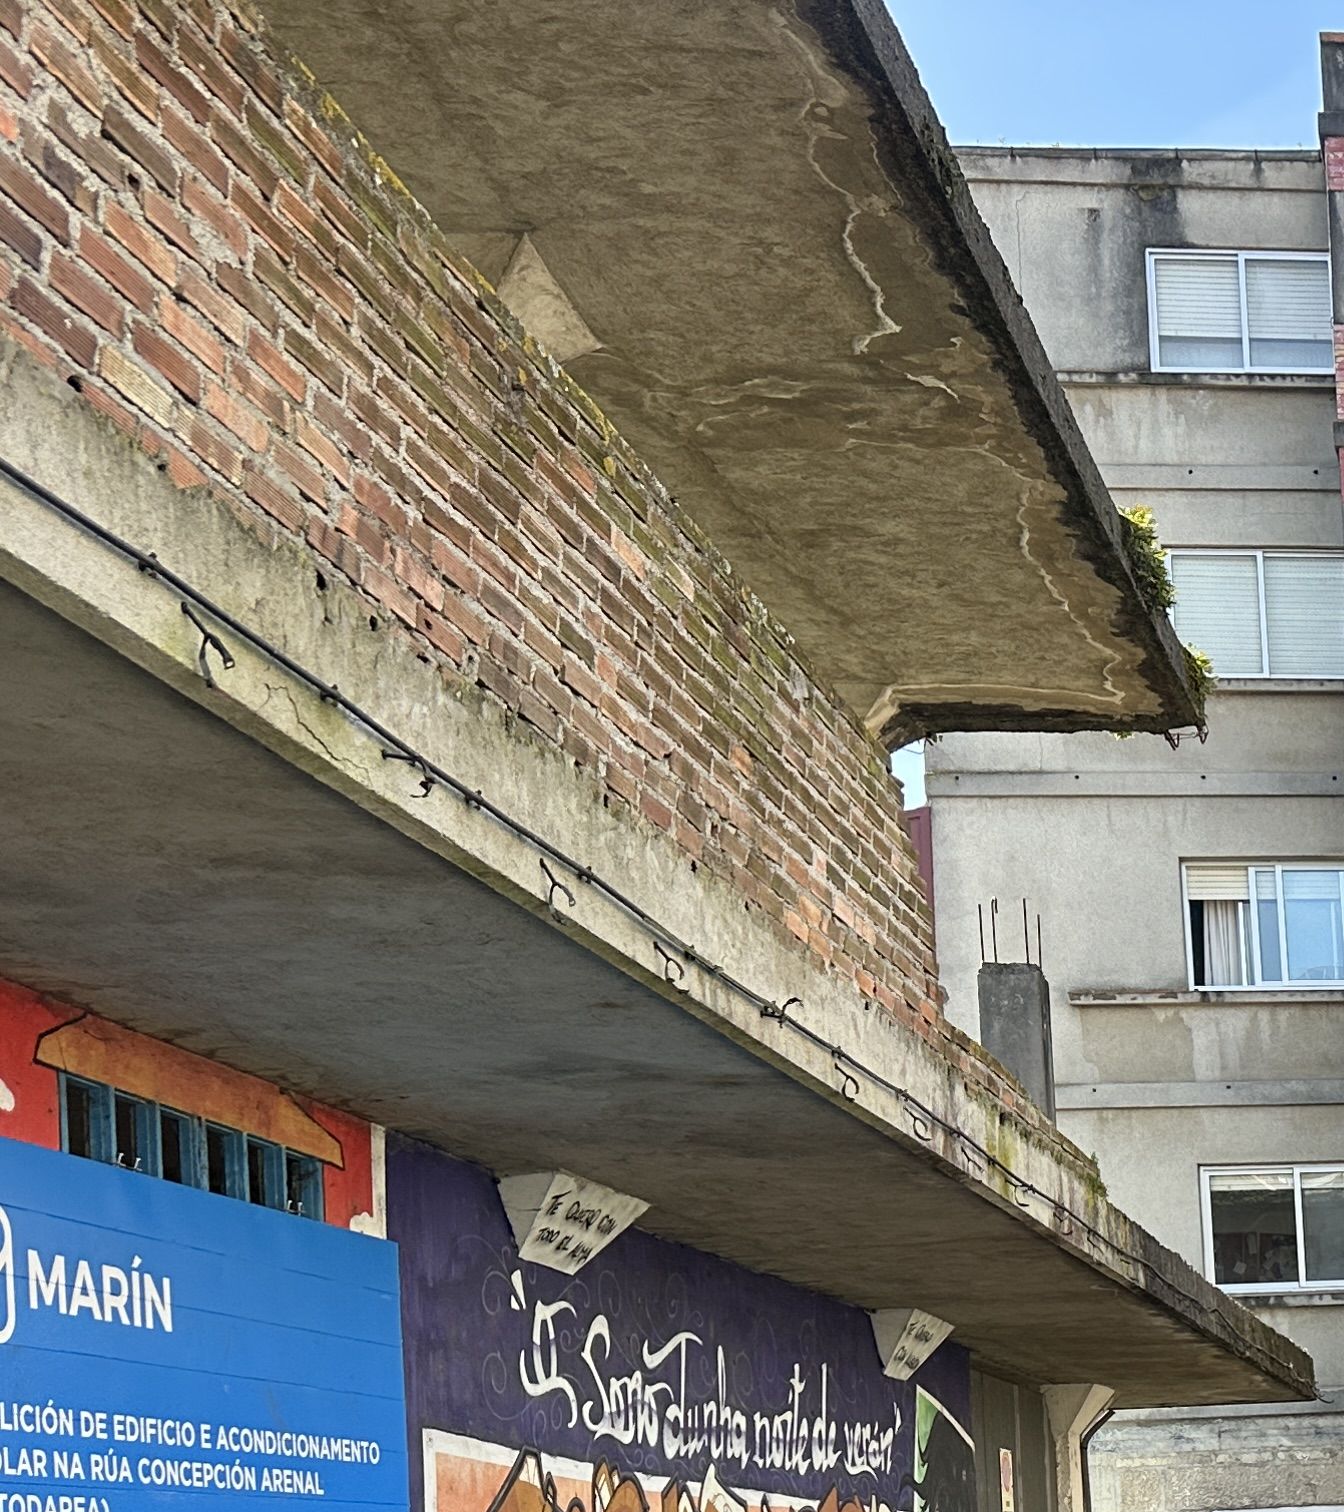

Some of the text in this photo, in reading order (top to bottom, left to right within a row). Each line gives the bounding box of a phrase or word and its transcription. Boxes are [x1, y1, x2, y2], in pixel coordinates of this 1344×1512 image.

[27, 1248, 173, 1333] MARÍN
[80, 1410, 108, 1440] DE
[113, 1414, 196, 1448] EDIFICIO
[200, 1423, 212, 1449] E
[216, 1425, 380, 1465] ACONDICIONAMENTO
[0, 1446, 325, 1496] LAR NA RÚA CONCEPCIÓN ARENAL
